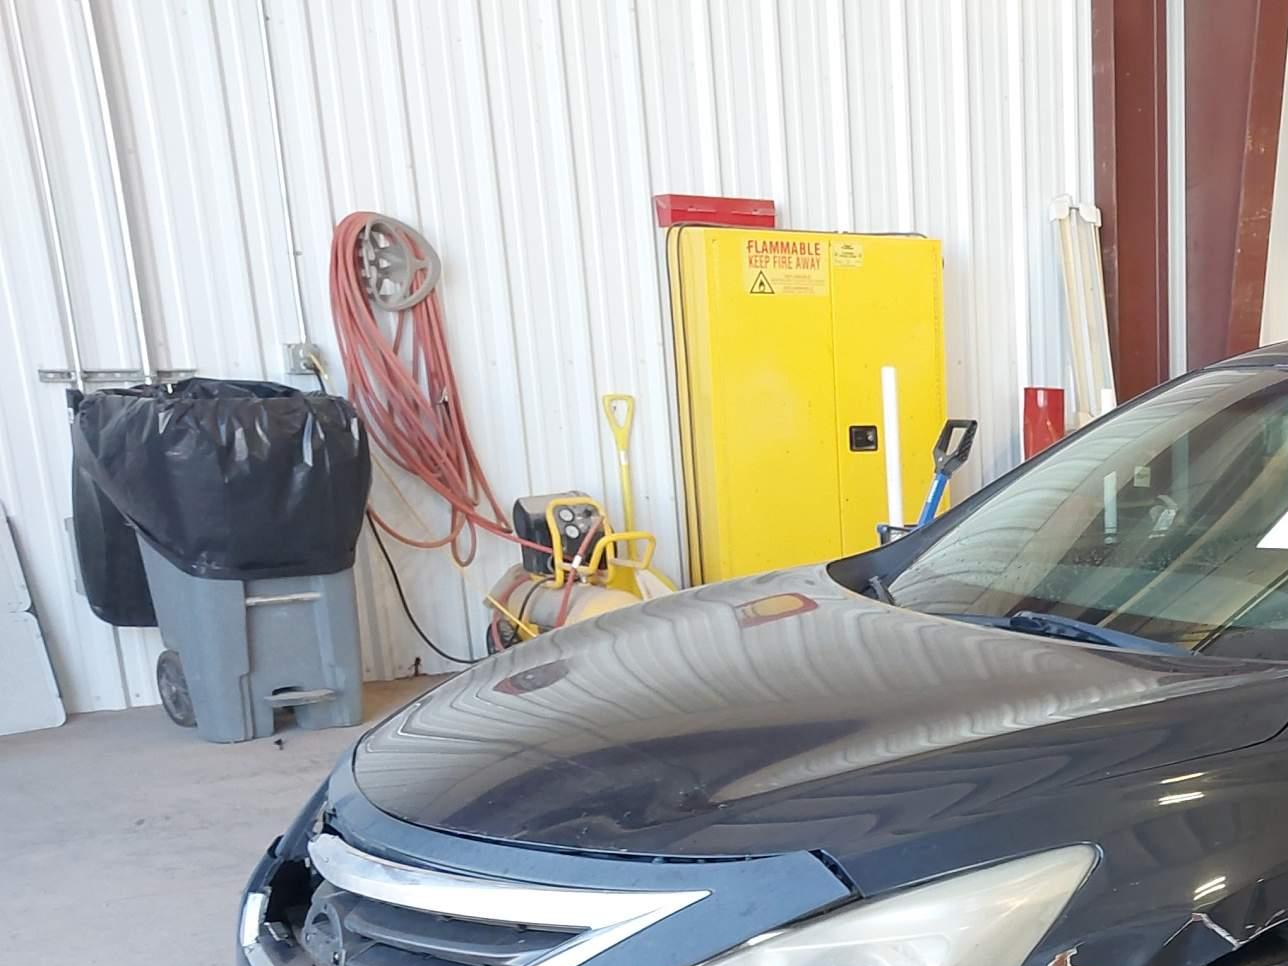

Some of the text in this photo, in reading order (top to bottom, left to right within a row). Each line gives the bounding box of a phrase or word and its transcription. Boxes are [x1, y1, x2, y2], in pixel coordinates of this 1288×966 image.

[747, 239, 821, 256] FLAMMABLE
[748, 255, 821, 271] KEEP FIRE AWAY
